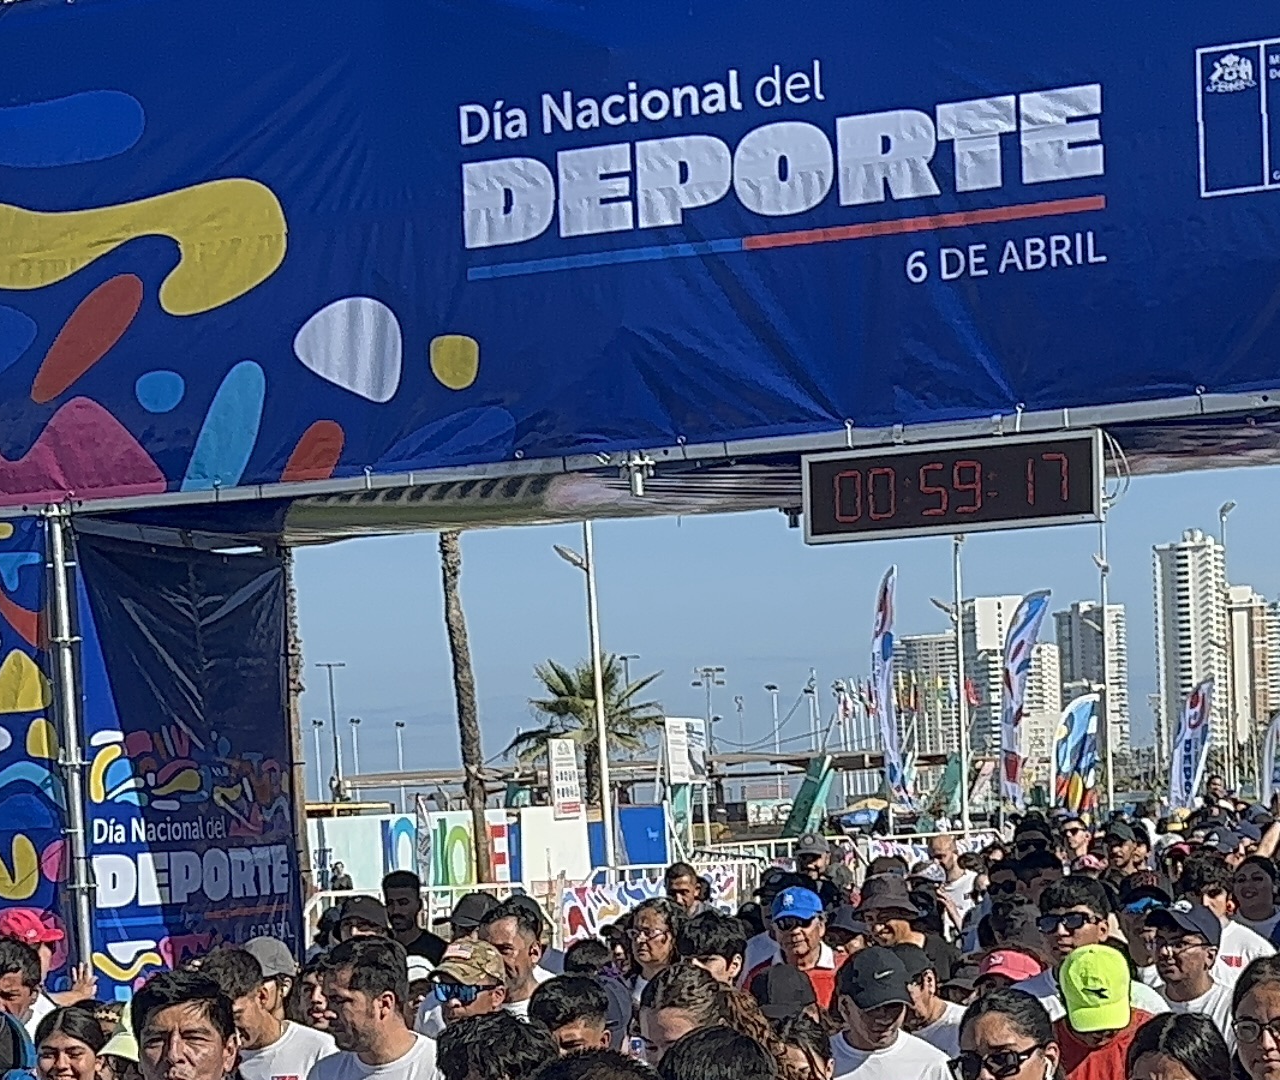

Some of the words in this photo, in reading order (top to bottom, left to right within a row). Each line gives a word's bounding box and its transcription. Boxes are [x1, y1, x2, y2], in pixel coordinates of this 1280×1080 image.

[459, 100, 528, 145] Día
[542, 69, 743, 134] Nacional
[755, 59, 825, 107] del
[461, 83, 1105, 249] DEPORTE
[906, 250, 928, 284] 6
[939, 244, 989, 280] DE
[998, 231, 1108, 274] ABRIL
[93, 818, 127, 844] Día
[131, 816, 205, 843] Nacional
[206, 815, 227, 839] del
[92, 844, 290, 909] DEPORTE
